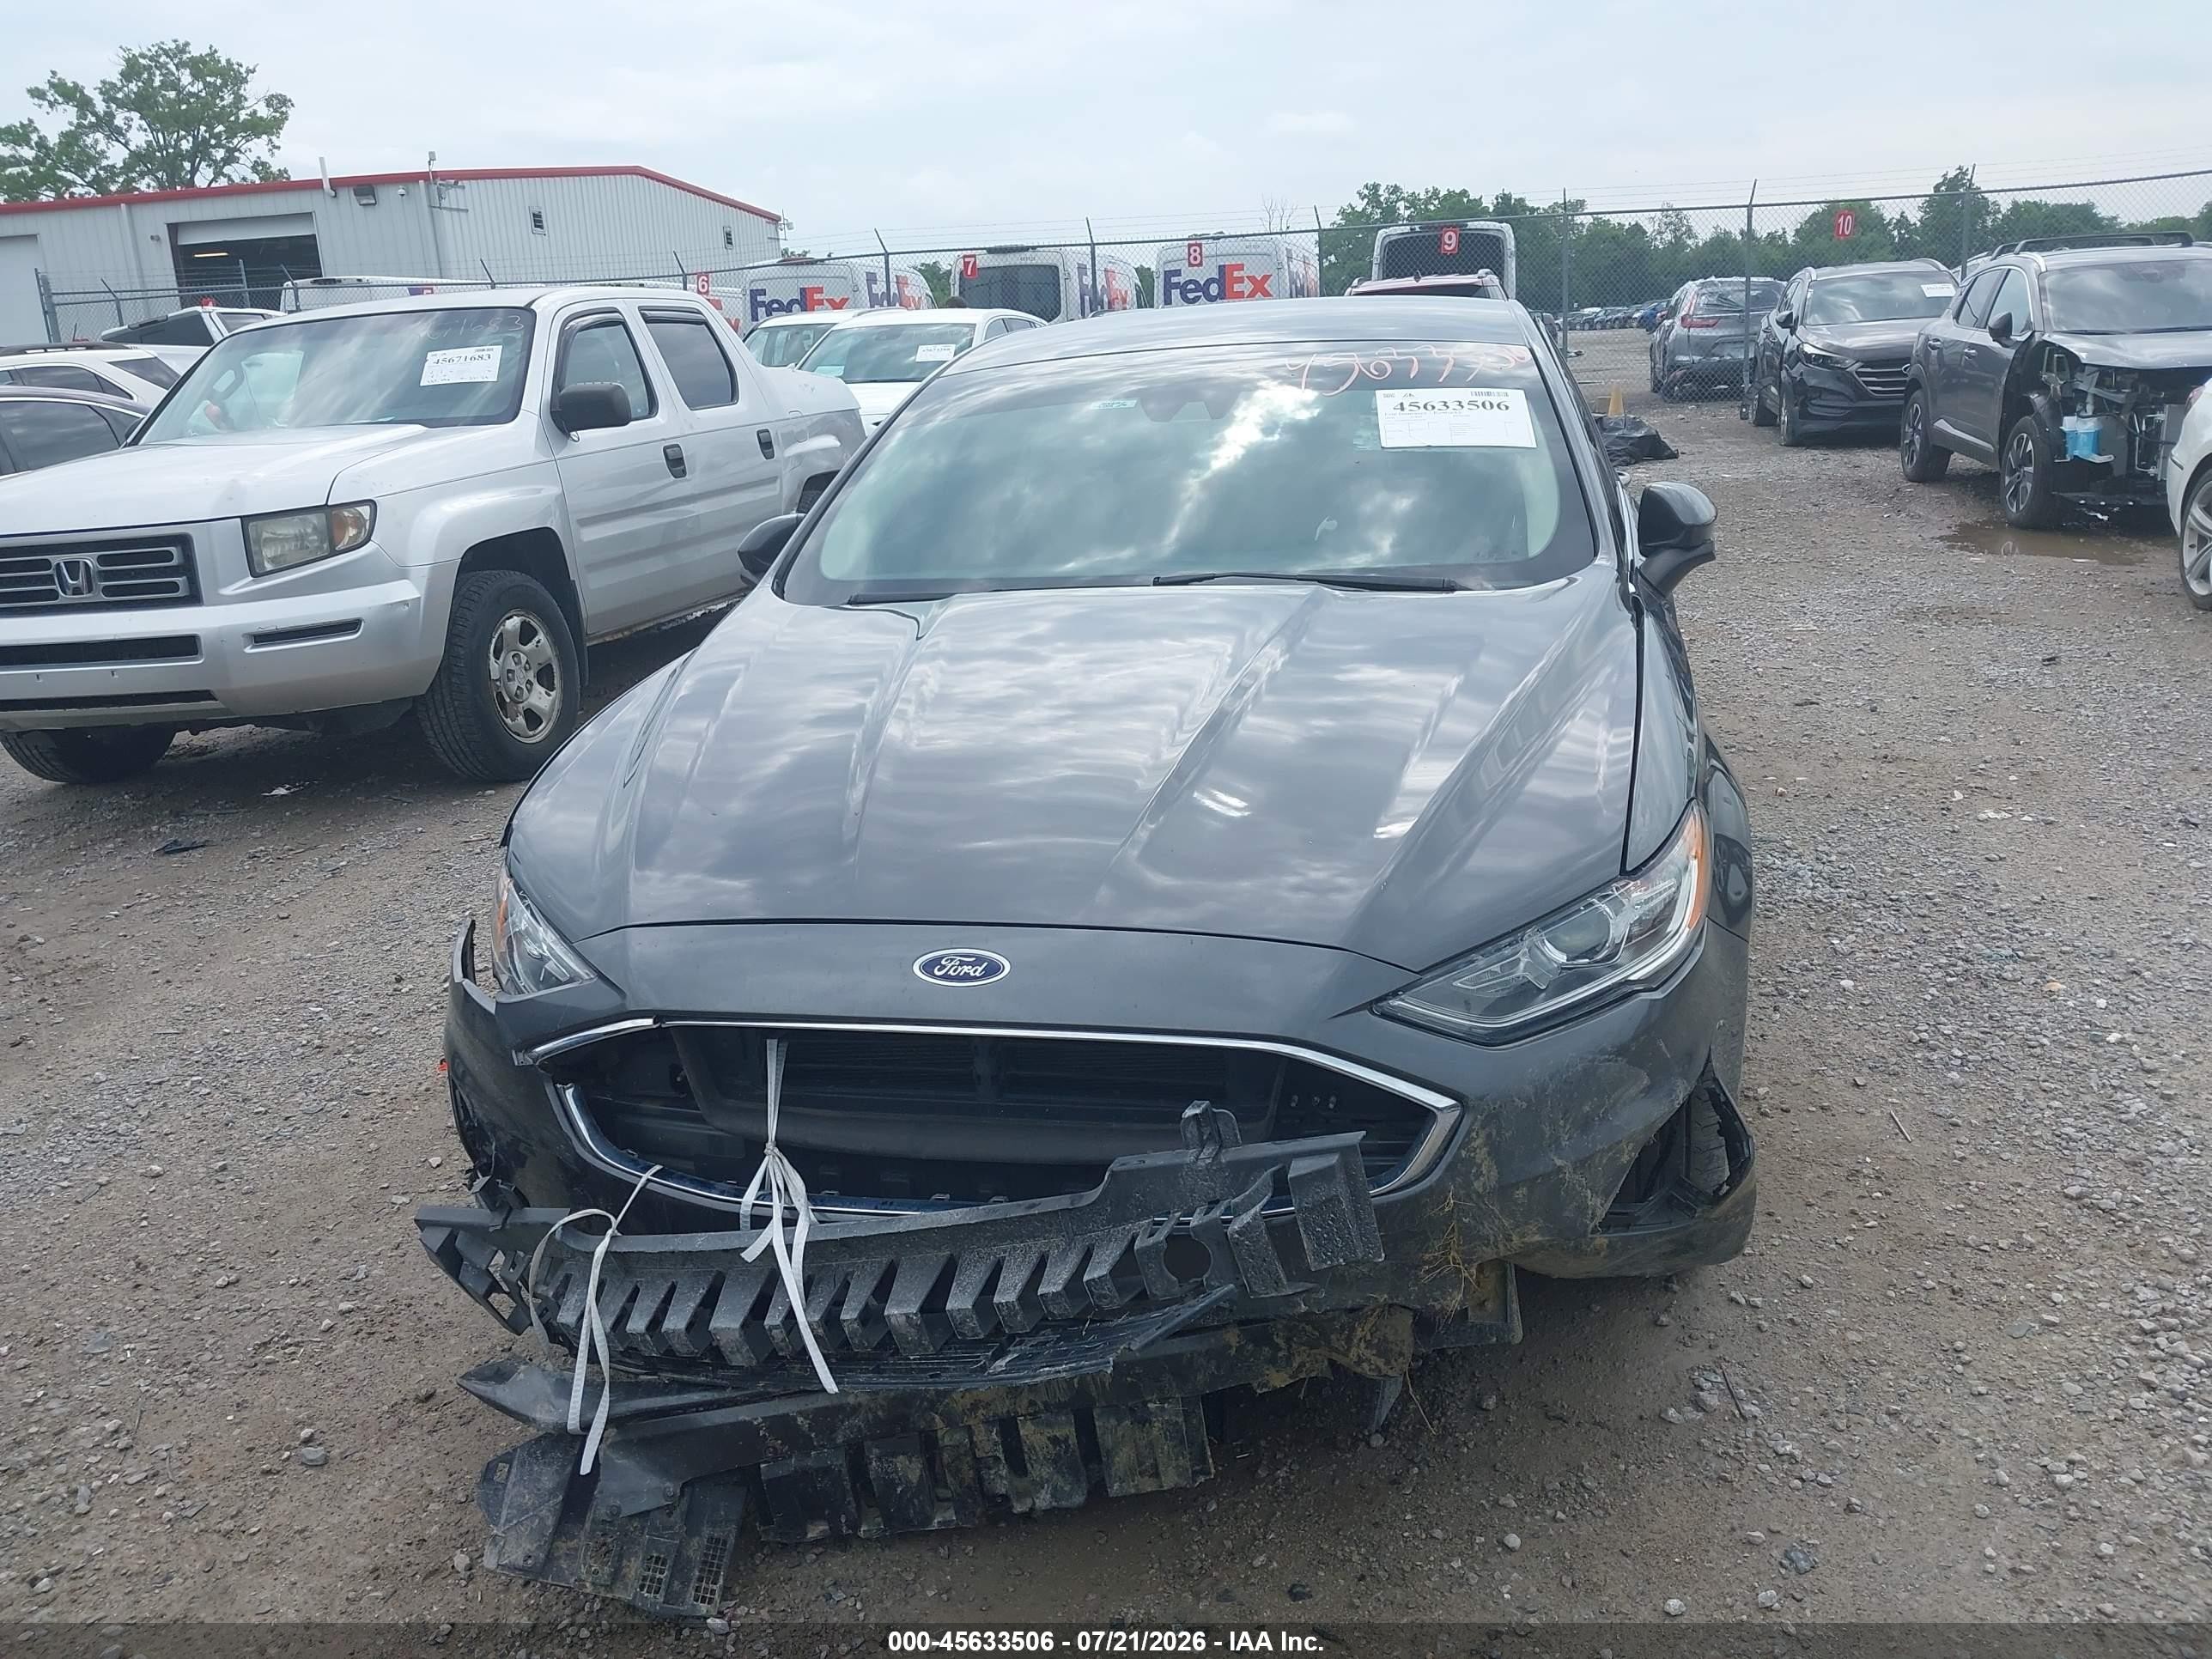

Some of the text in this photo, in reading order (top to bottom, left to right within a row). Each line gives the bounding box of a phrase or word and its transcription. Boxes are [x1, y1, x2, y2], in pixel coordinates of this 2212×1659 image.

[1838, 215, 1852, 234] 10
[1443, 231, 1456, 250] 9
[1189, 246, 1201, 264] 8
[963, 258, 975, 275] 7
[698, 276, 708, 293] 6
[1164, 264, 1273, 306] FedEx
[432, 353, 491, 365] 45671683
[1393, 399, 1510, 412] 45633506
[933, 956, 988, 977] Ford
